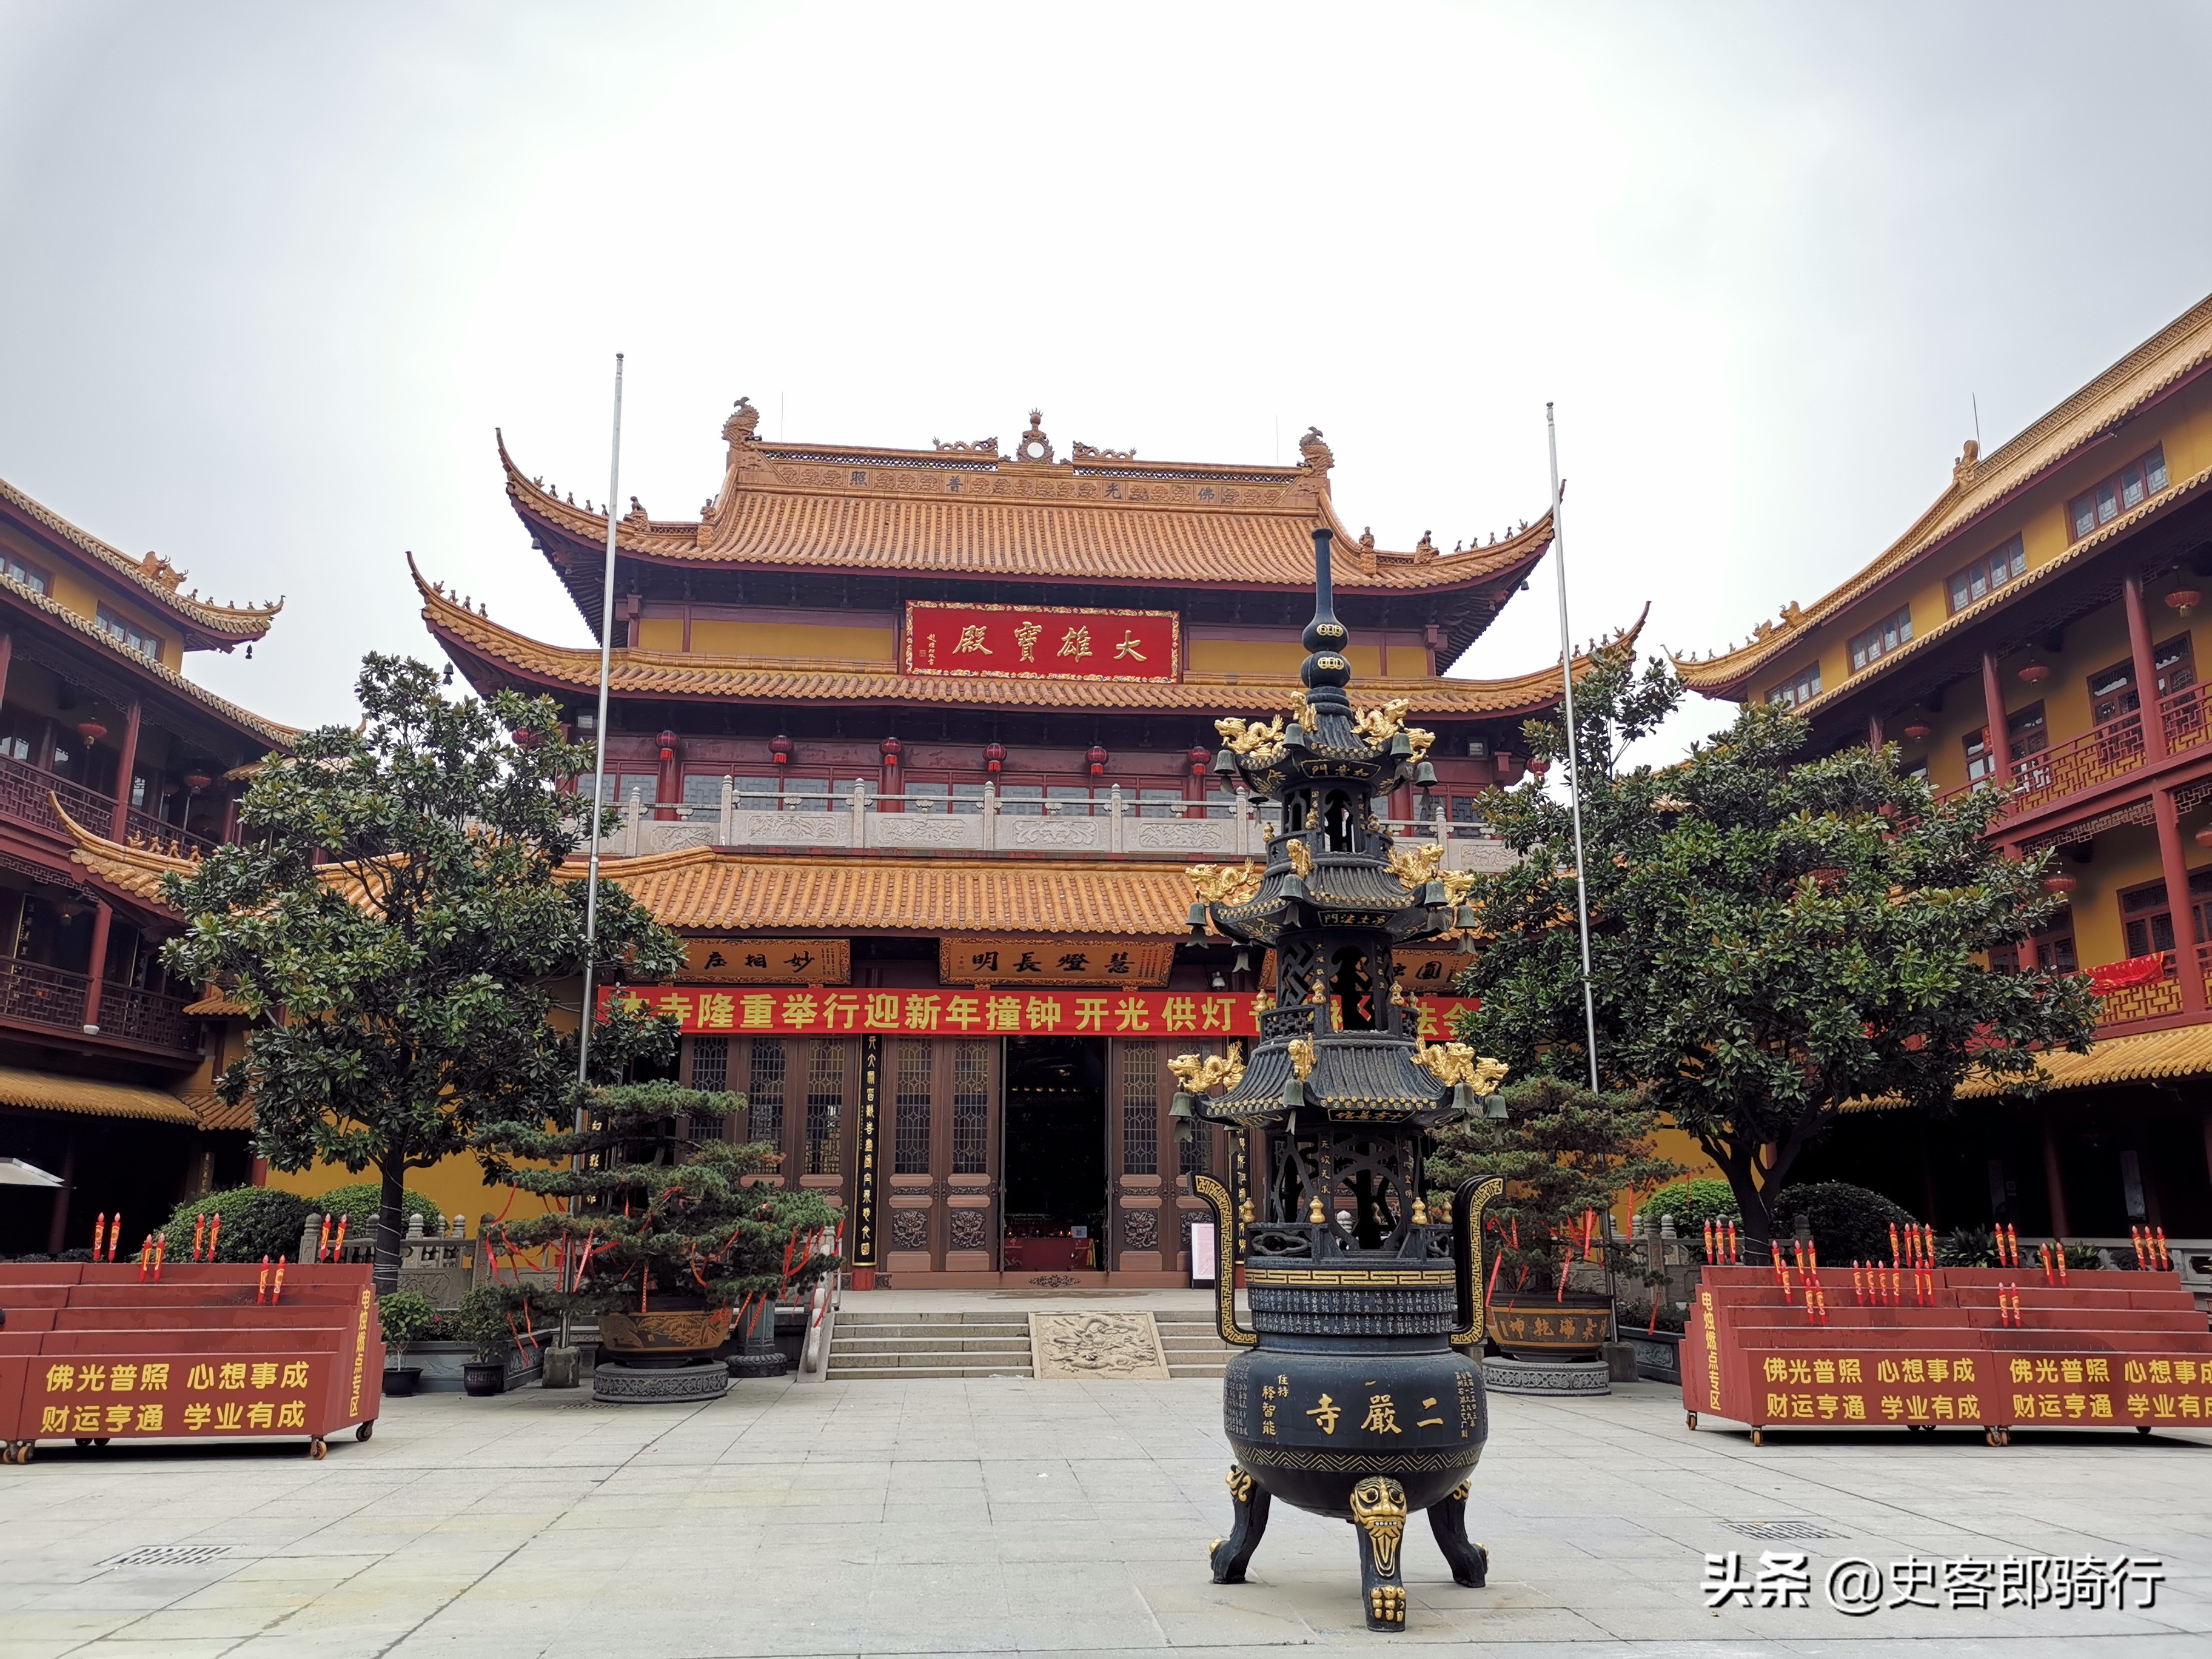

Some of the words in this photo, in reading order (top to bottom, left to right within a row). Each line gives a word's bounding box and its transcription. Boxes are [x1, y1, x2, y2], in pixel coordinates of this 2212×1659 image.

[953, 622, 1147, 663] 大雄寶殿
[349, 1289, 370, 1417] 电烛燃点专区
[1701, 1292, 1721, 1410] 电烛燃点专区
[46, 1363, 170, 1392] 佛光普照
[187, 1361, 309, 1390] 心想事成
[1763, 1357, 1863, 1385] 佛光普照
[1877, 1358, 1975, 1383] 心想事成
[2009, 1358, 2110, 1384] 佛光普照
[41, 1403, 164, 1433] 财运亨通
[184, 1399, 306, 1430] 学业有成
[1766, 1393, 1866, 1419] 财运亨通
[1881, 1394, 1980, 1420] 学业有成
[2013, 1393, 2113, 1418] 财运亨通
